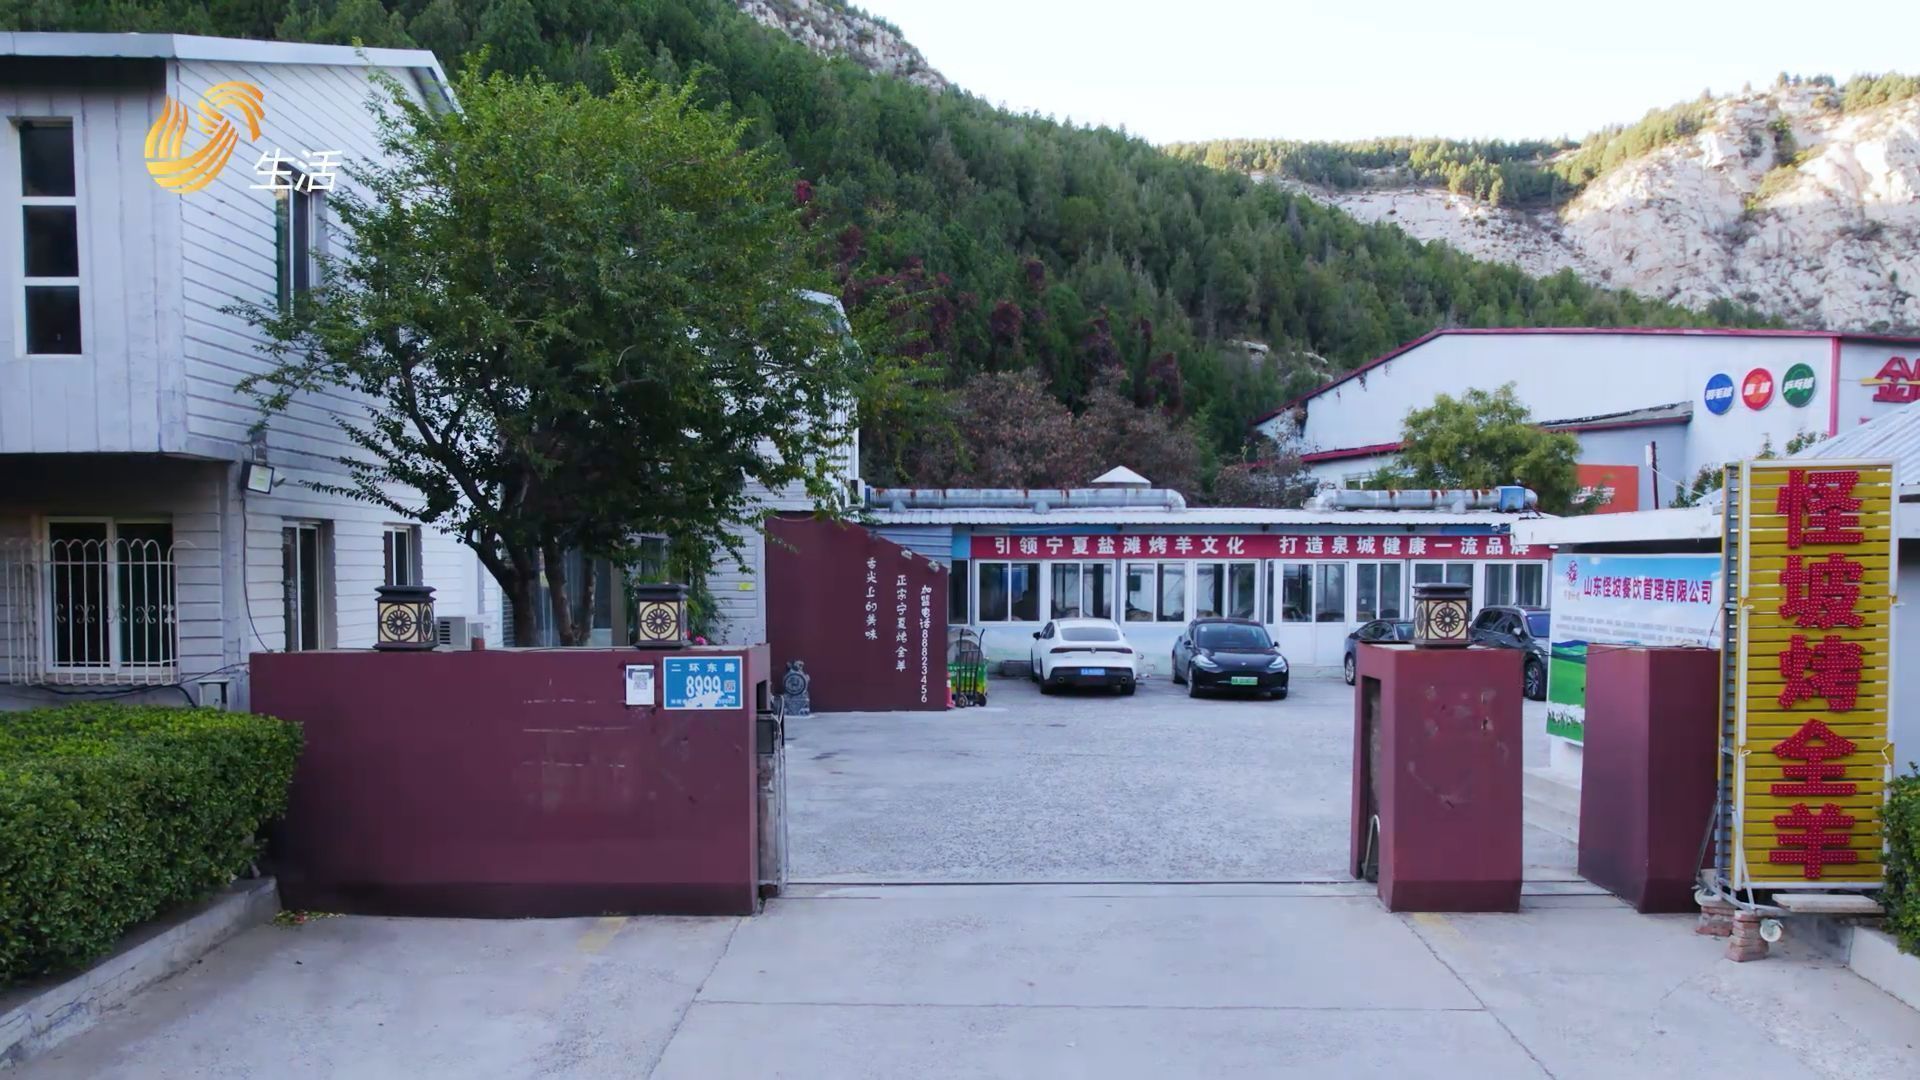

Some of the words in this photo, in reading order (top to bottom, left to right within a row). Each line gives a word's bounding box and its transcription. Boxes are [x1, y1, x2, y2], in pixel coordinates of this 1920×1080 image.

[994, 536, 1246, 555] 引领宁夏盐滩烤羊文化
[865, 556, 878, 641] 舌尖上的美味
[1584, 575, 1713, 605] 山东怪坡餐饮管理有限公司
[895, 574, 908, 673] 正宗宁夏烤全羊
[671, 662, 736, 673] 二环东路
[1768, 468, 1865, 880] 怪坡烤全羊
[685, 675, 722, 698] 8999
